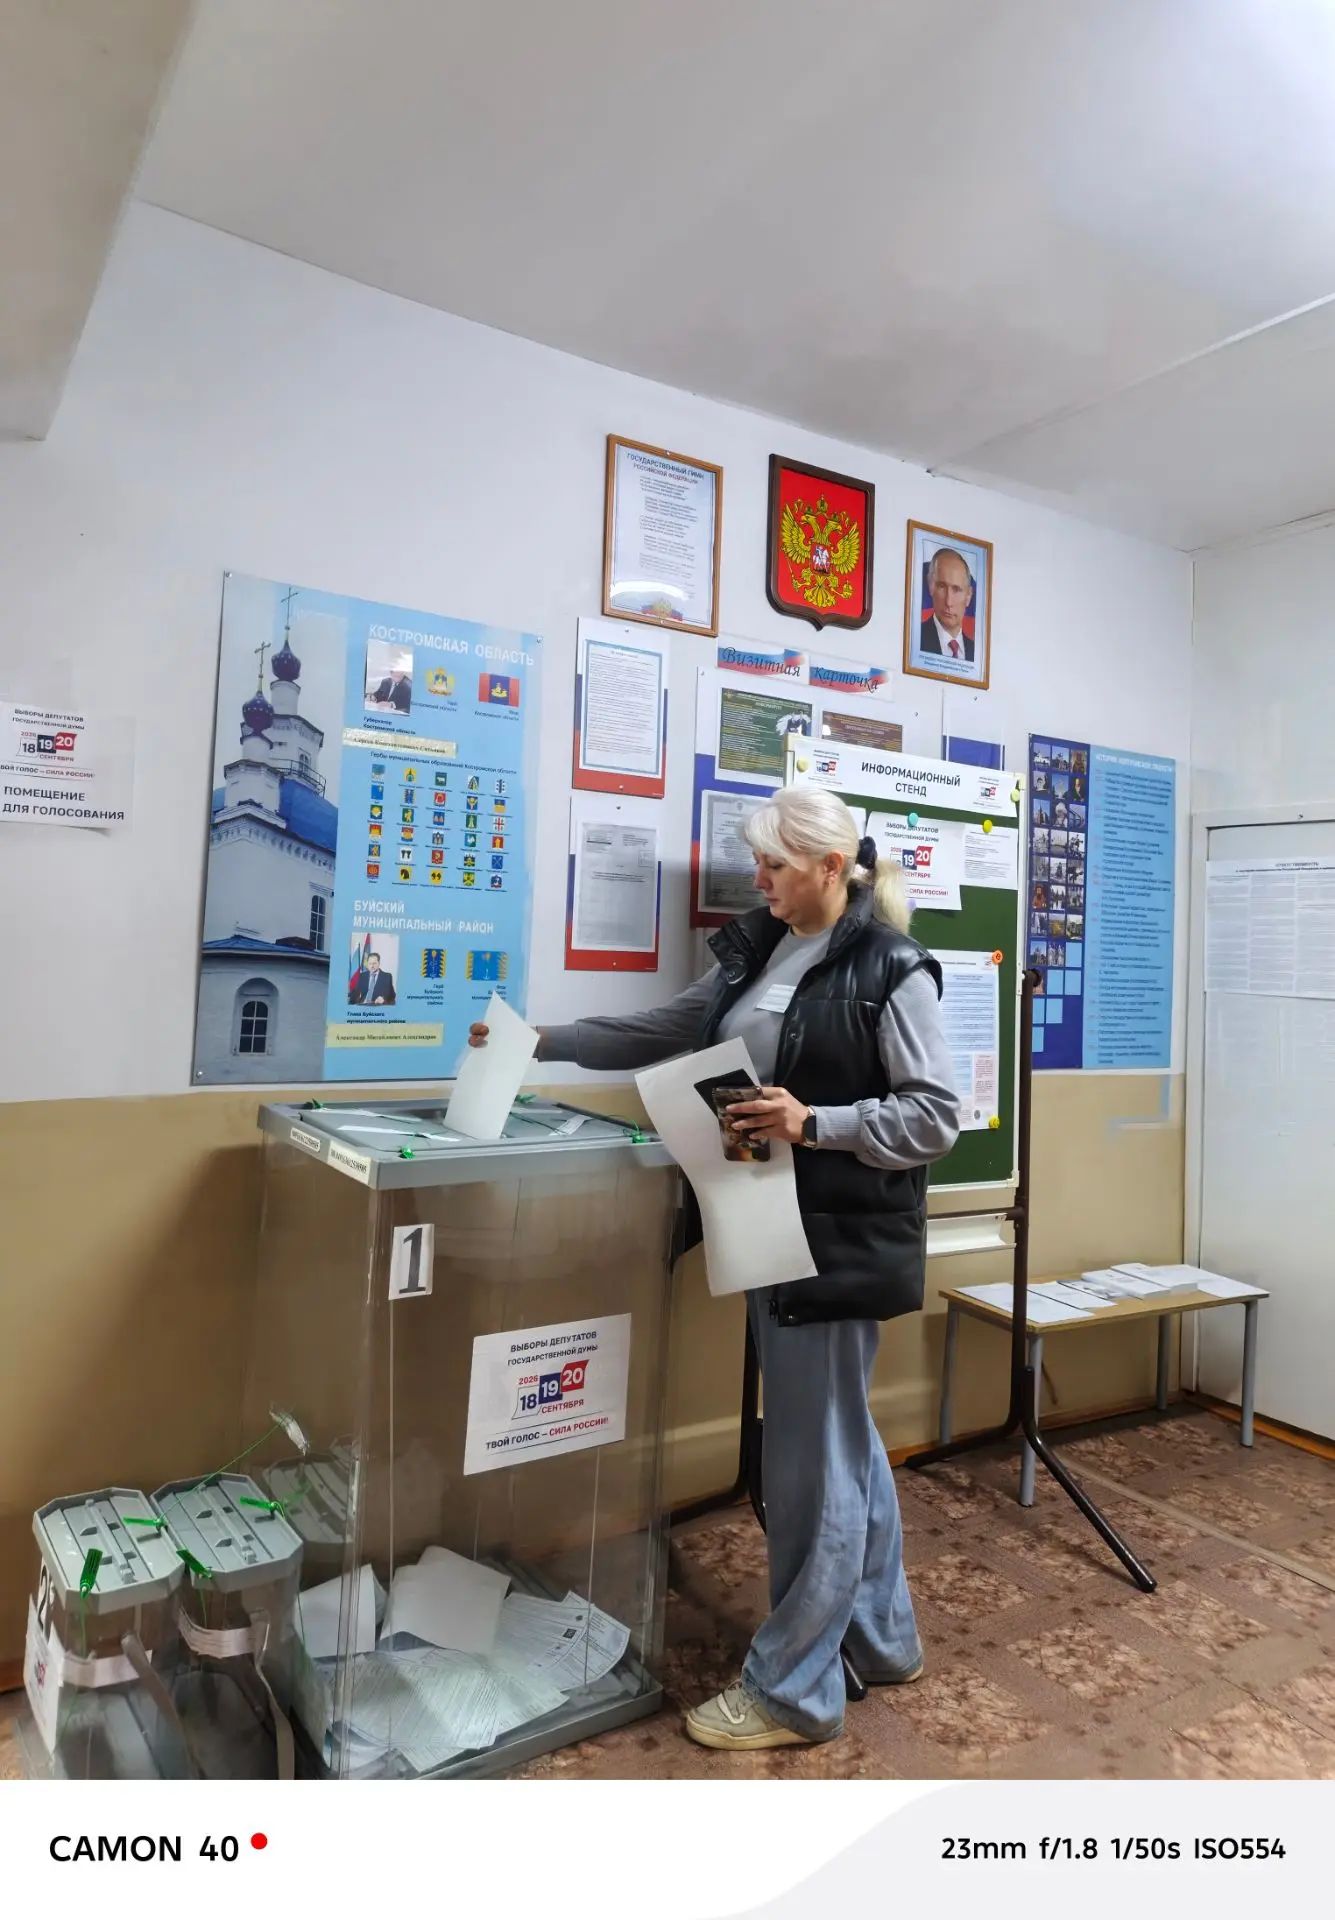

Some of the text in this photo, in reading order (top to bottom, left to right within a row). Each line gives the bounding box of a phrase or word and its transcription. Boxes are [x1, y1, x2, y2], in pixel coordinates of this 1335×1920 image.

[626, 452, 705, 480] ГОСУДАРСТВЕННЫЙ ГИМН
[633, 463, 668, 478] РОССИЙСКОЙ
[369, 624, 535, 666] КОСТРОМСКАЯ ОБЛАСТЬ
[722, 646, 801, 677] Визитная
[12, 717, 67, 728] ГОСУДАРСТВЕННОЙ
[14, 708, 84, 722] ВЫБОРЫ ДЕПУТАТОВ
[22, 736, 73, 753] 18 19 20
[39, 754, 74, 762] СЕНТЯБРЯ
[15, 765, 39, 774] ГОЛОС
[861, 761, 961, 787] ИНФОРМАЦИОННЫЙ
[4, 785, 86, 802] ПОМЕЩЕНИЕ
[895, 782, 927, 797] СТЕНД
[2, 803, 125, 820] ДЛЯ ГОЛОСОВАНИЯ
[886, 821, 906, 830] ВЫБОРЫ
[884, 831, 924, 841] ГОСУДАРСТВЕННОЙ
[903, 854, 915, 866] 19
[916, 850, 930, 862] 20
[354, 899, 404, 913] БУЙСКИЙ
[353, 915, 494, 934] МУНИЦИПАЛЬНЫЙ РАЙОН
[398, 1227, 426, 1294] 1
[510, 1330, 597, 1353] ВЫБОРЫ ДЕПУТАТОВ
[507, 1344, 598, 1366] ГОСУДАРСТВЕННОЙ ДУМЫ
[518, 1375, 539, 1386] 2026
[519, 1367, 584, 1411] 18 19 20
[541, 1398, 585, 1414] СЕНТЯБРЯ
[485, 1436, 510, 1451] ТВОЙ
[510, 1431, 540, 1444] ГОЛОС
[549, 1424, 572, 1437] СИЛА
[573, 1417, 609, 1432] РОССИИ!
